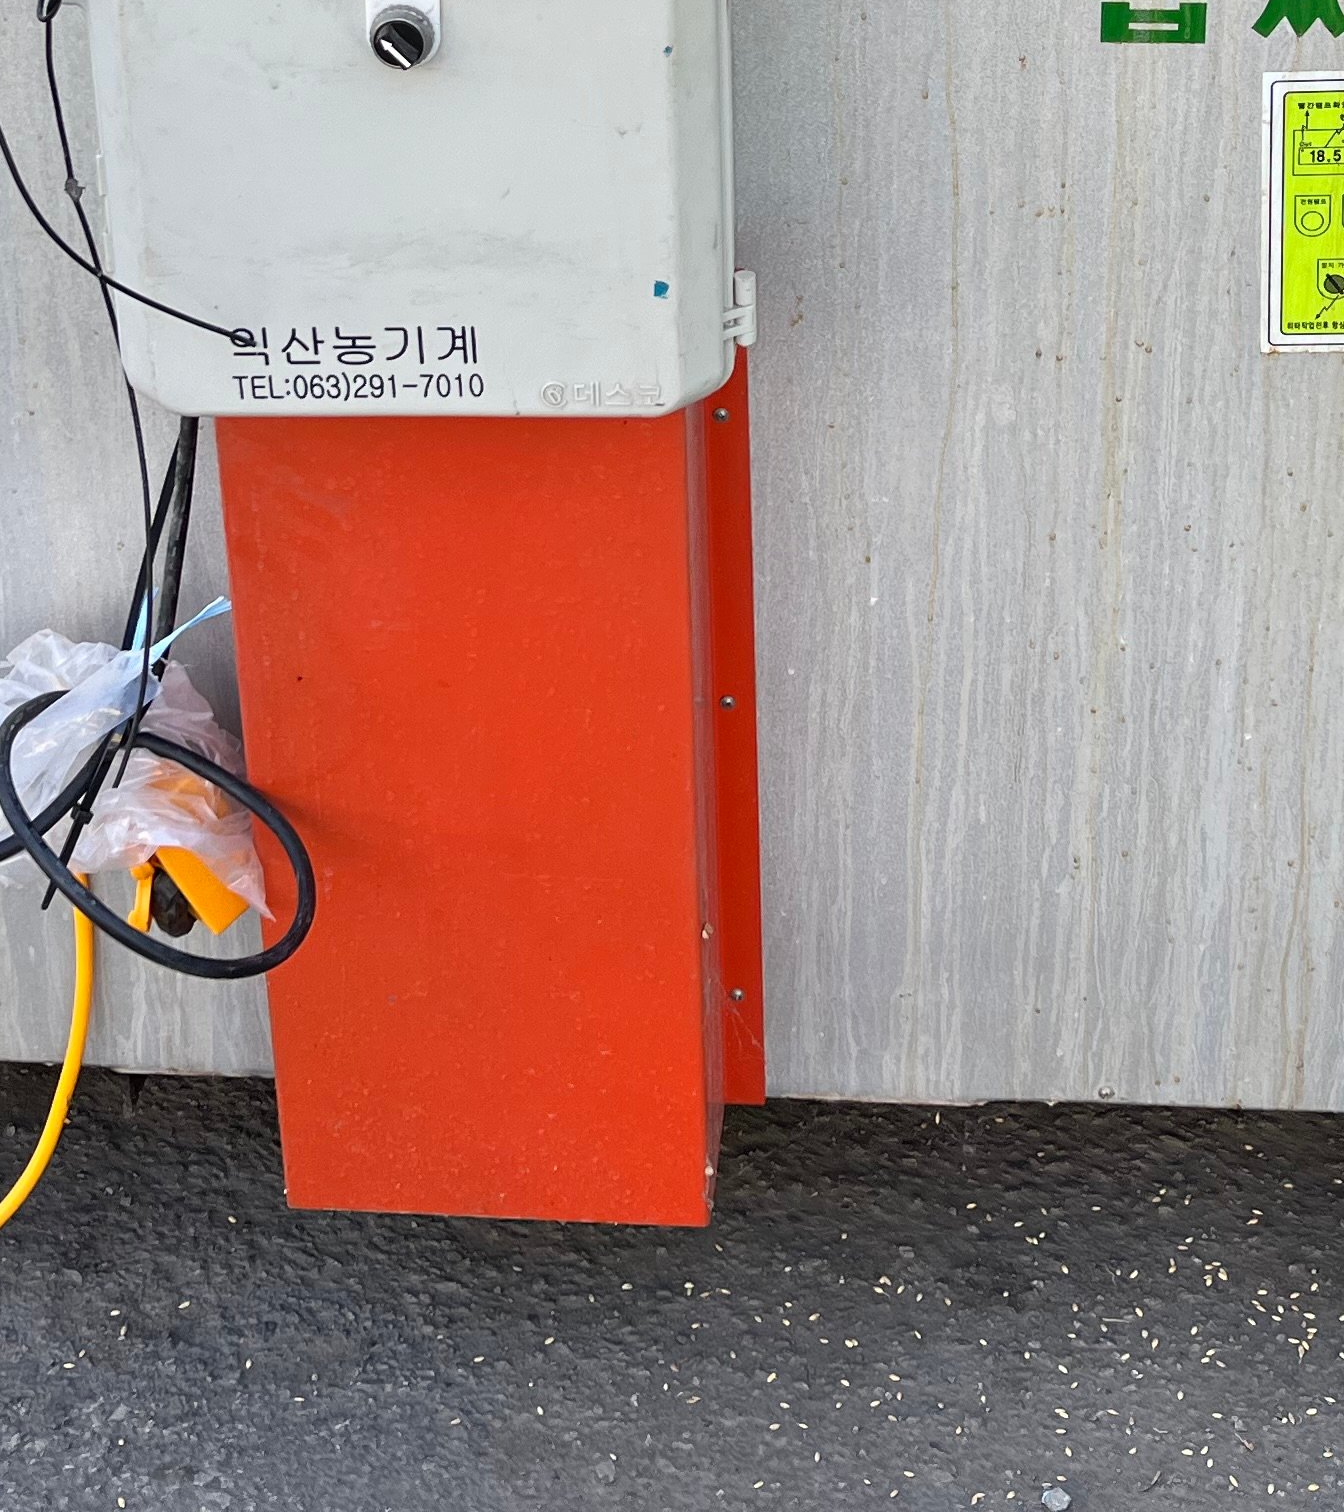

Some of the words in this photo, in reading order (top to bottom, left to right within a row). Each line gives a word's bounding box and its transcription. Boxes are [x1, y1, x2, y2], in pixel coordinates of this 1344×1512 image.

[1310, 150, 1341, 163] 18.5
[231, 325, 479, 366] 익산농기계
[232, 374, 484, 401] TEL:063)291-7010
